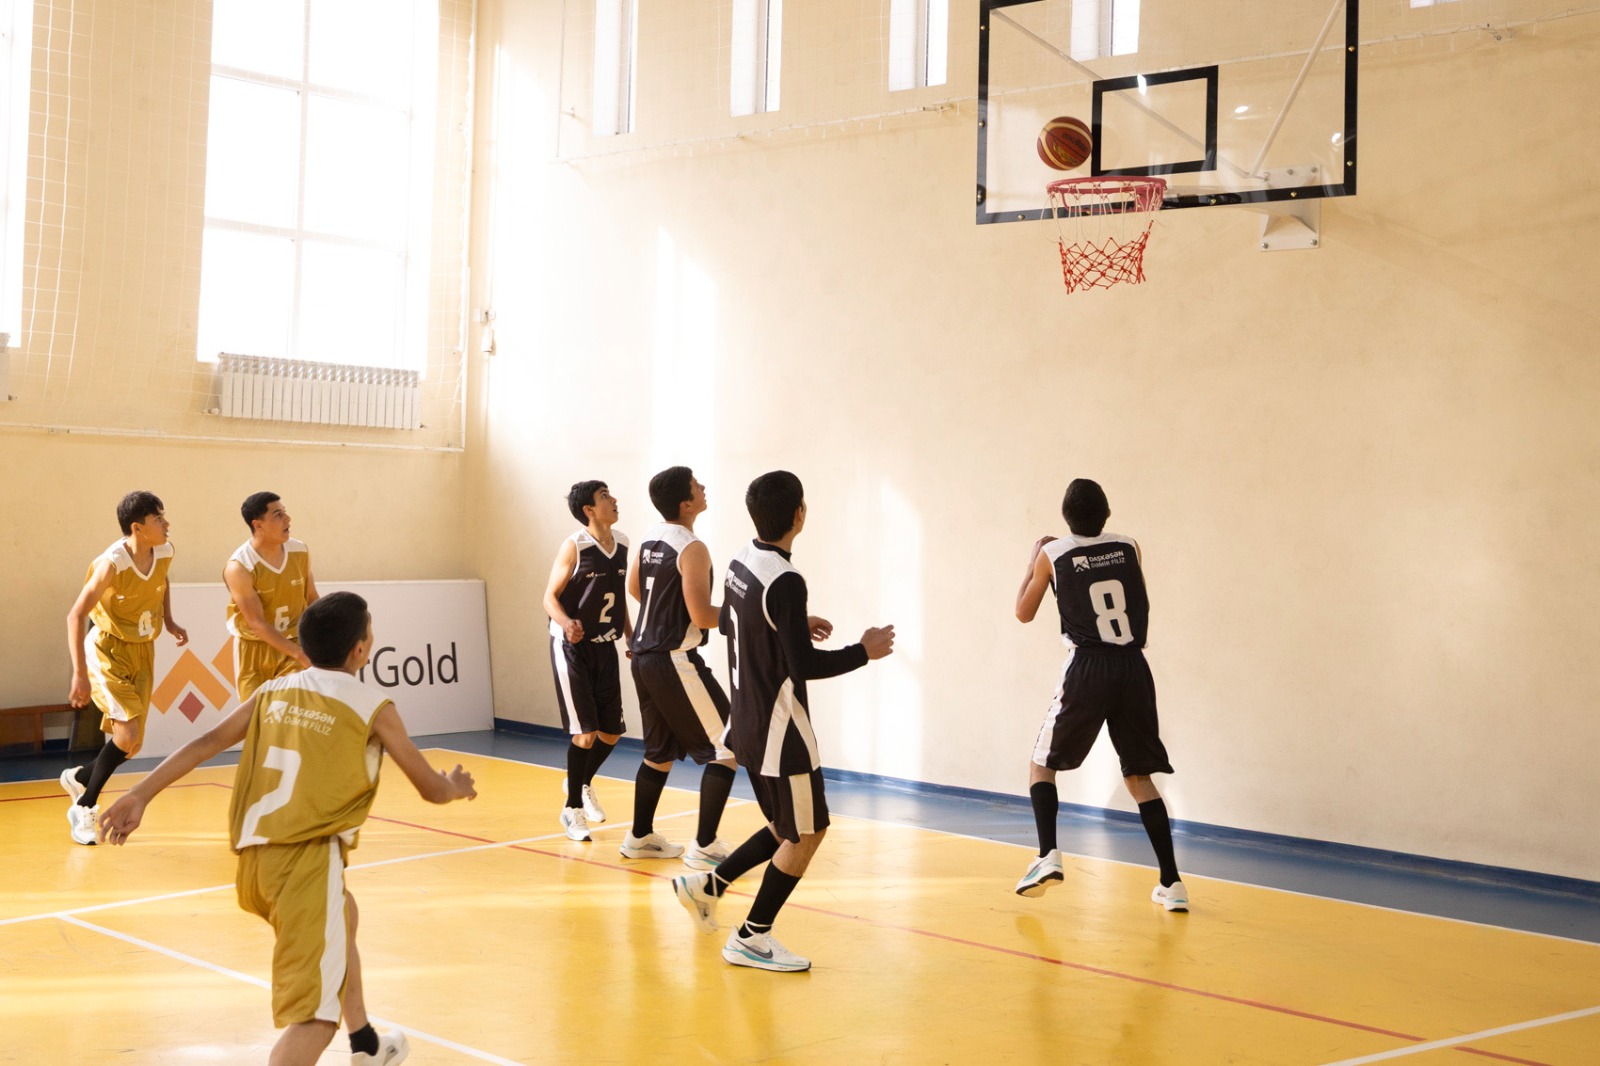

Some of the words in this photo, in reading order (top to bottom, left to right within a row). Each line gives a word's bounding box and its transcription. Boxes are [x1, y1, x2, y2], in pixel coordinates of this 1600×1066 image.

[275, 606, 289, 632] 6
[599, 592, 615, 623] 2
[1089, 579, 1134, 645] 8
[138, 610, 155, 640] 4
